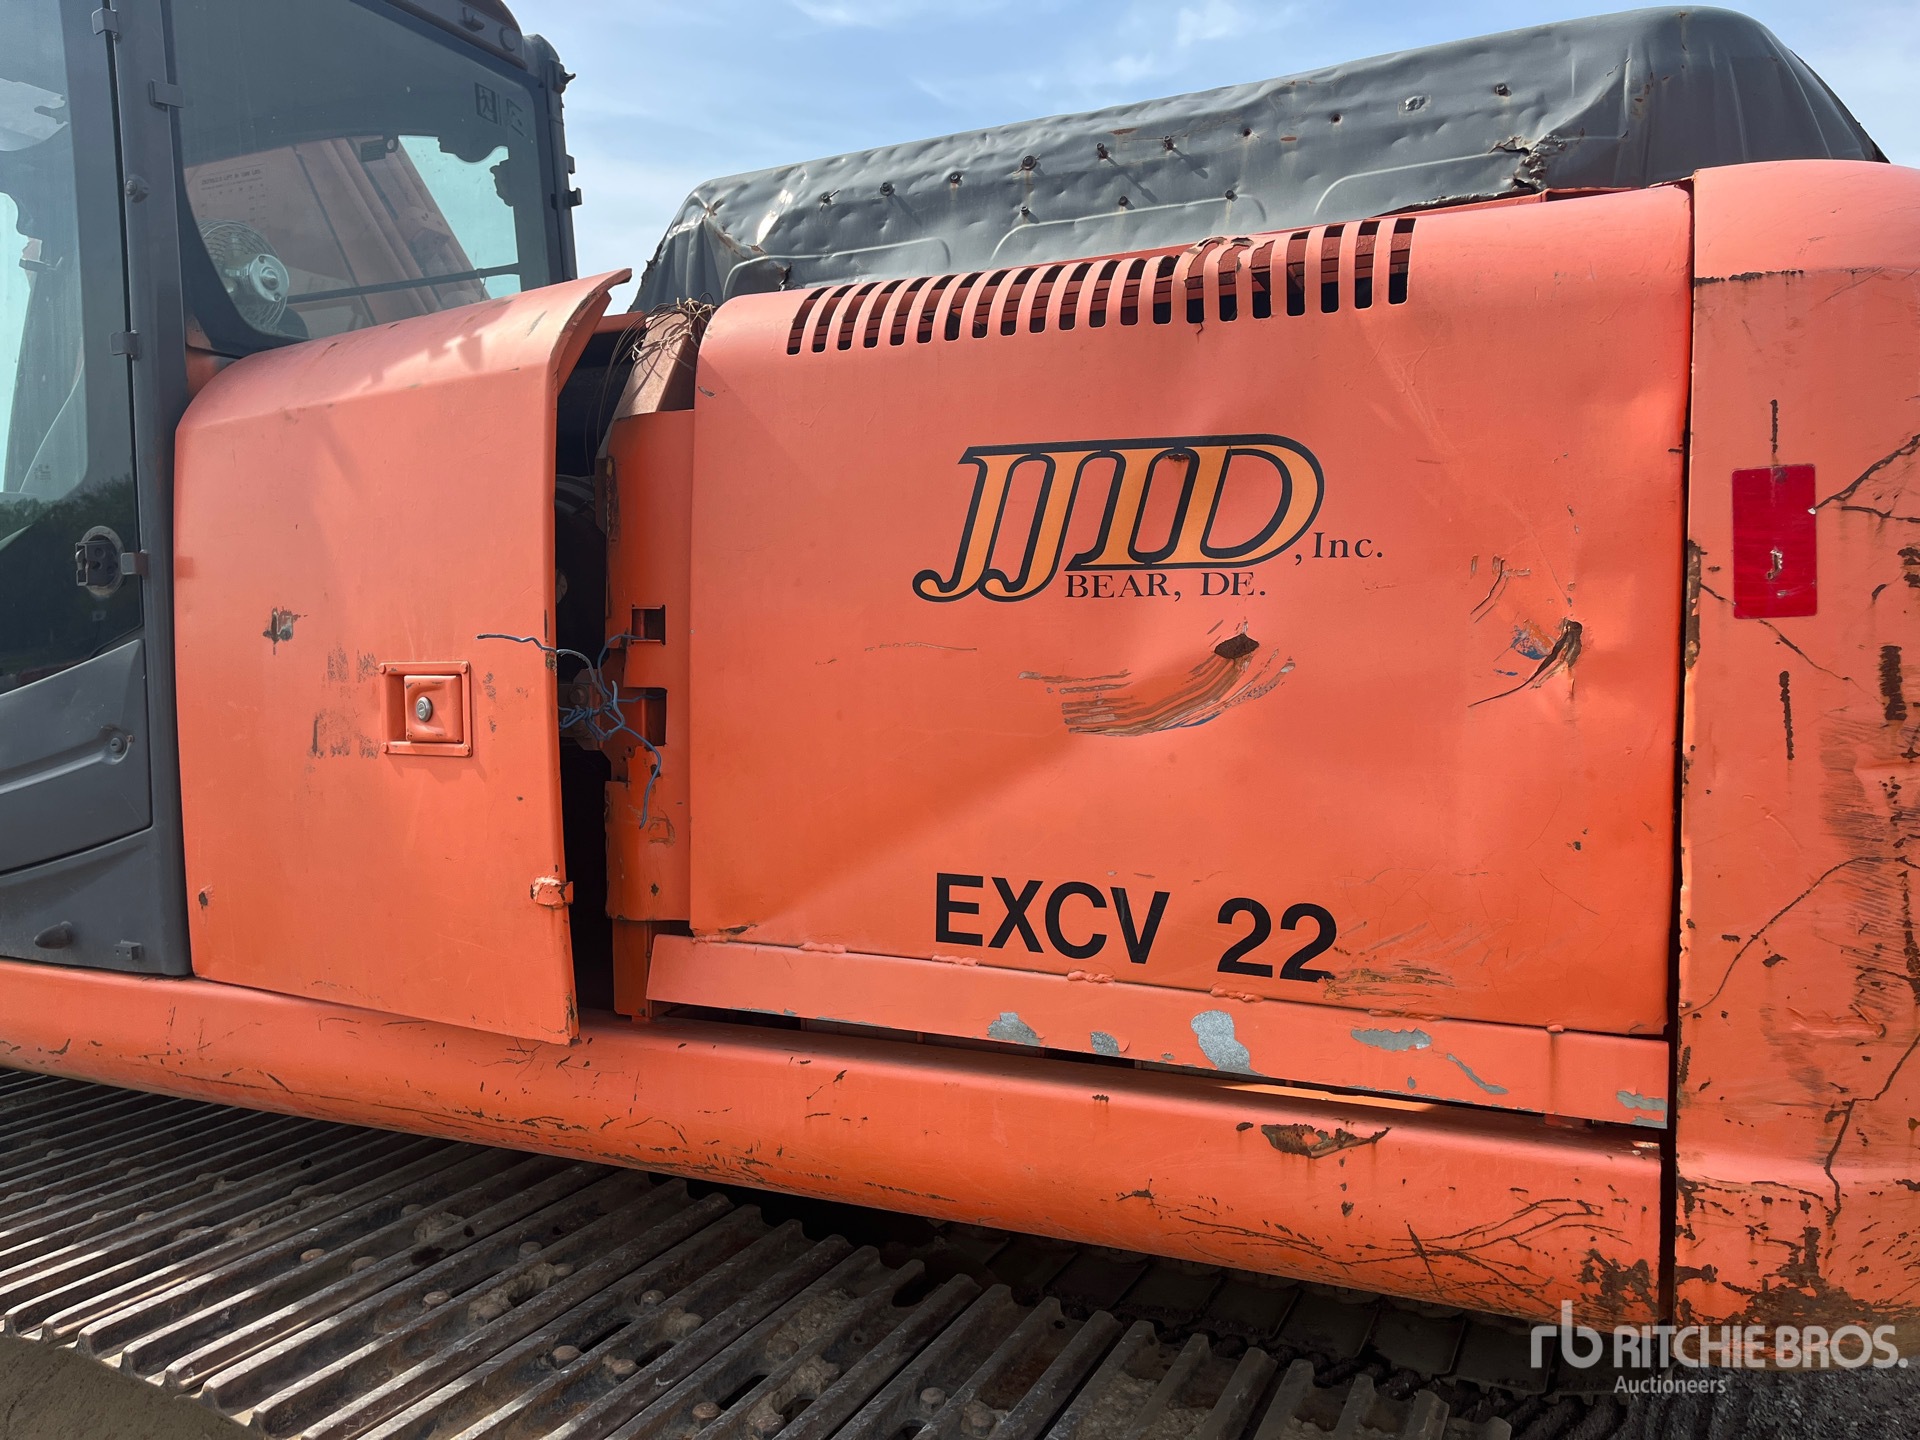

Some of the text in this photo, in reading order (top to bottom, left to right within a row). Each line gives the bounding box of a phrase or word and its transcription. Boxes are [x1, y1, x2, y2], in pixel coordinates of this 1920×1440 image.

[1065, 571, 1267, 602] BEAR, DE.
[935, 872, 1337, 982] EXCV 22
